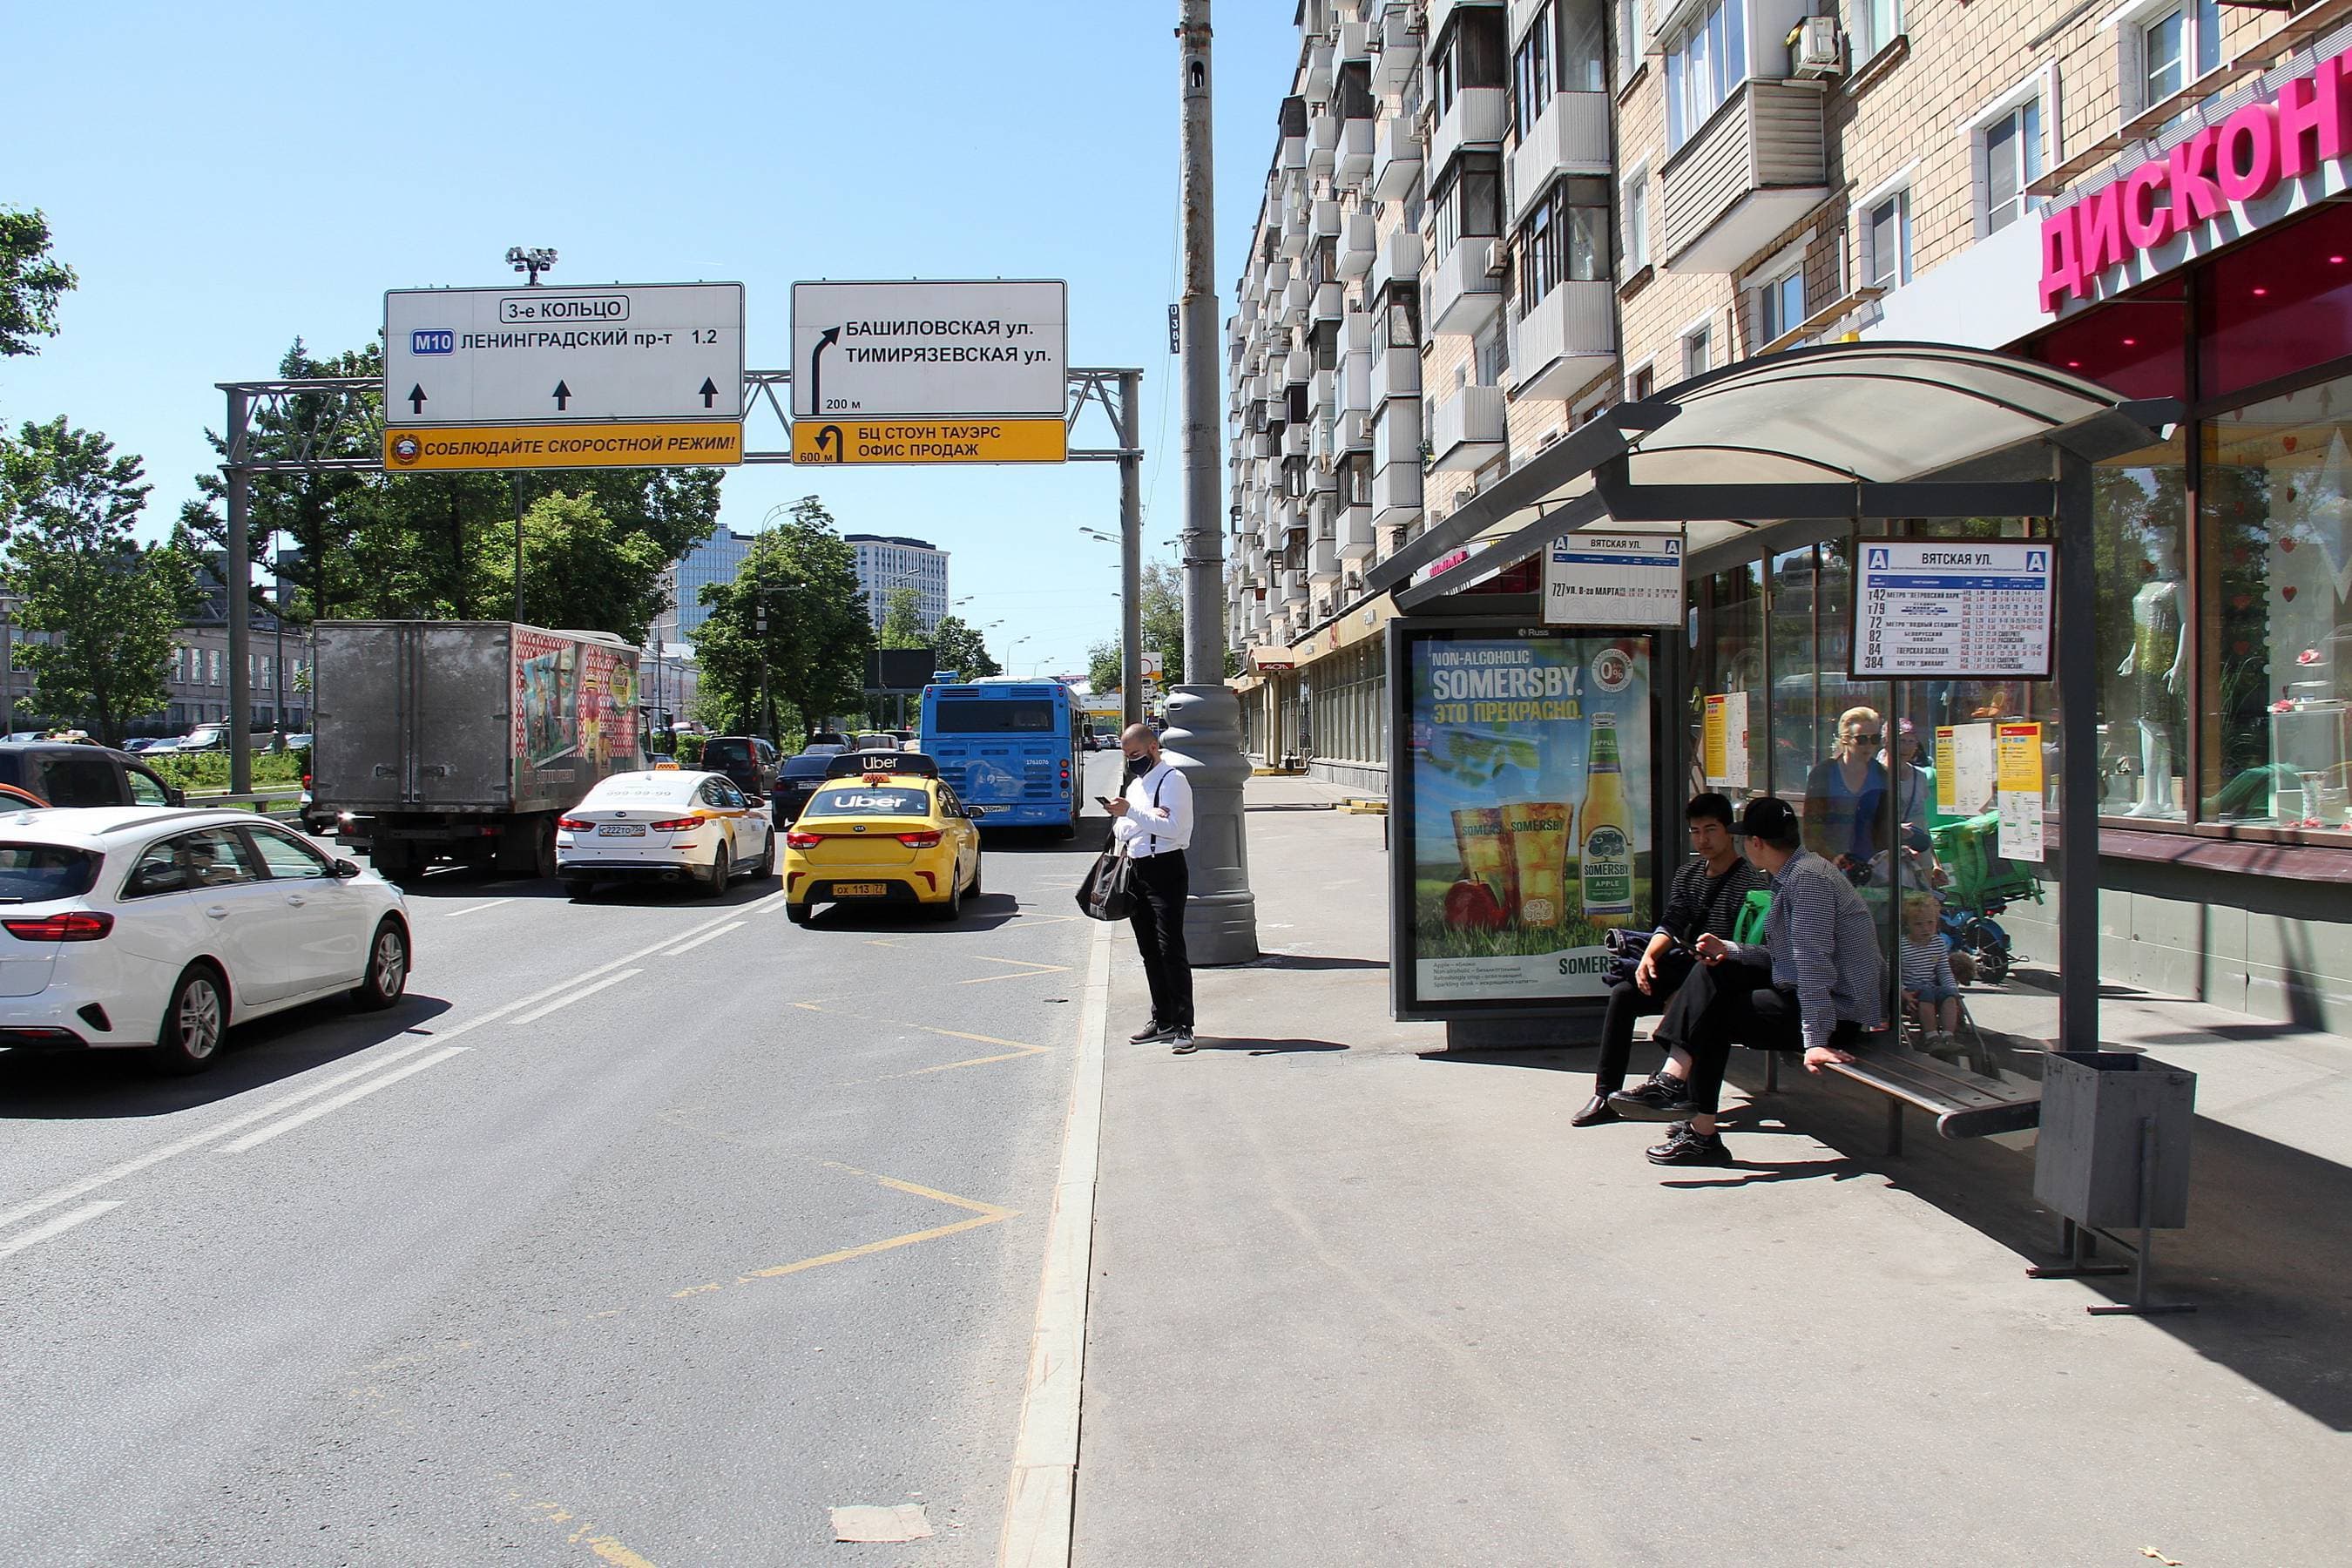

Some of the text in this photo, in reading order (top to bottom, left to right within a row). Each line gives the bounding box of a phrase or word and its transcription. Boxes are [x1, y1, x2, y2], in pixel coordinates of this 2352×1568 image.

[508, 301, 622, 319] 3-е КОЛЬЦО
[846, 320, 1034, 340] БАШИЛОВСКАЯ ул.
[1170, 305, 1179, 352] 0381
[461, 328, 628, 350] ЛЕНИНГРАДСКИЙ
[633, 332, 672, 349] пр-т
[692, 329, 718, 345] 1.2
[846, 347, 1051, 367] ТИМИРЯЗЕВСКАЯ ул.
[826, 398, 861, 409] 200 м
[859, 425, 1001, 443] БЦ СТОУН ТАУЭРС
[424, 435, 736, 457] СОБЛЮДАЙТЕ СКОРОСТНОЙ РЕЖИМ!
[859, 443, 979, 459] ОФИС ПРОДАЖ
[800, 452, 821, 463] 600
[1591, 539, 1641, 549] ВЯТСКАЯ УЛ.
[1922, 552, 1992, 565] ВЯТСКАЯ УЛ.
[1552, 583, 1565, 597] 727
[1566, 585, 1578, 595] УЛ.
[1595, 586, 1619, 596] МАРТА
[1870, 616, 1882, 628] 72
[1869, 630, 1882, 642] 82
[1869, 643, 1881, 655] 84
[1432, 650, 1530, 666] NON-ALCOHOLIC
[1865, 657, 1883, 668] 384
[1433, 666, 1583, 700] SOMERSBY.
[1434, 700, 1582, 724] ЭТО ПРЕКРАСНО.
[862, 756, 898, 769] Uber
[835, 795, 906, 808] Uber
[1511, 819, 1564, 833] SOMERSBY
[1584, 863, 1628, 876] SOMERSBY
[853, 884, 869, 894] 113
[875, 884, 884, 894] 77
[1559, 955, 1618, 975] SOMERS
